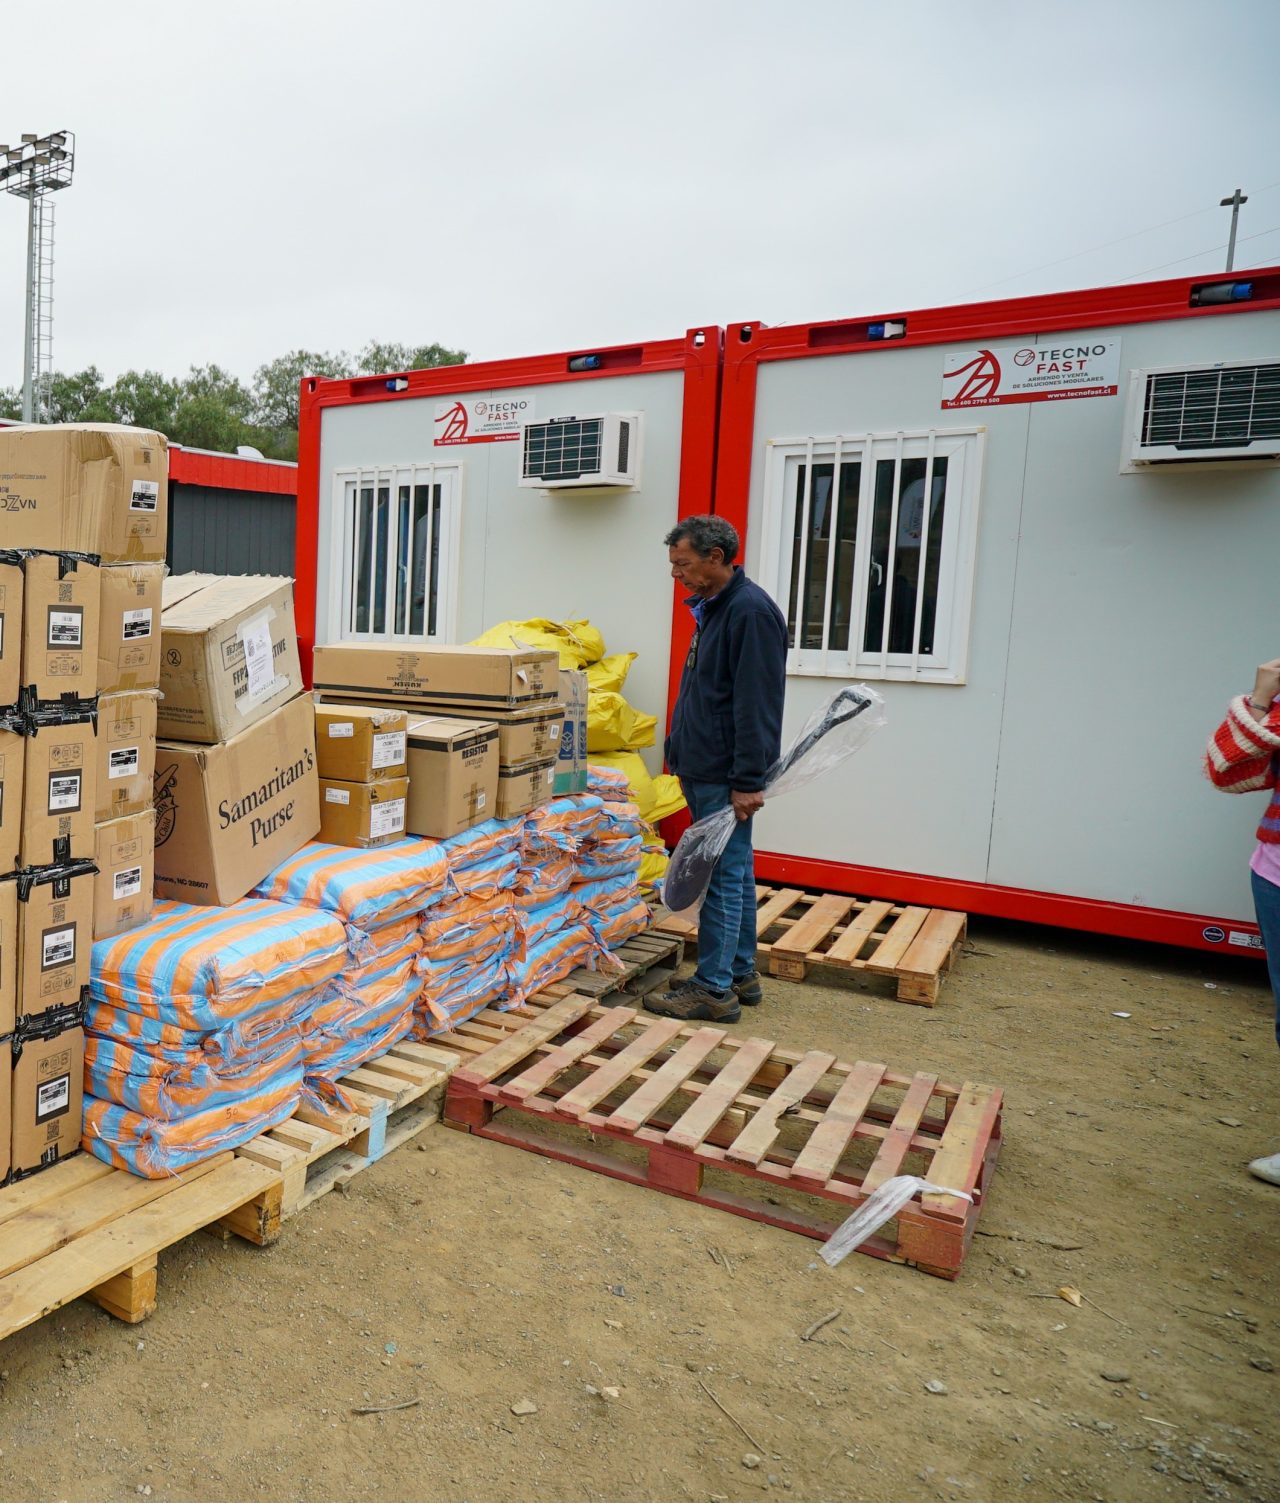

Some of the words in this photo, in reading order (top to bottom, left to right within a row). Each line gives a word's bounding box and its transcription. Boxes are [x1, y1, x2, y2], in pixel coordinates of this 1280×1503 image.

[1039, 344, 1106, 362] TECNO
[1036, 360, 1088, 375] FAST
[1022, 379, 1062, 388] SOLUCIONES
[1063, 376, 1105, 385] MODULARES
[1027, 374, 1061, 383] ARRIENDO
[1047, 387, 1112, 399] www.tecnofast.cl
[488, 400, 528, 413] TECNO
[487, 411, 516, 422] FAST
[461, 743, 488, 760] RESISTOR
[249, 801, 295, 849] Purse
